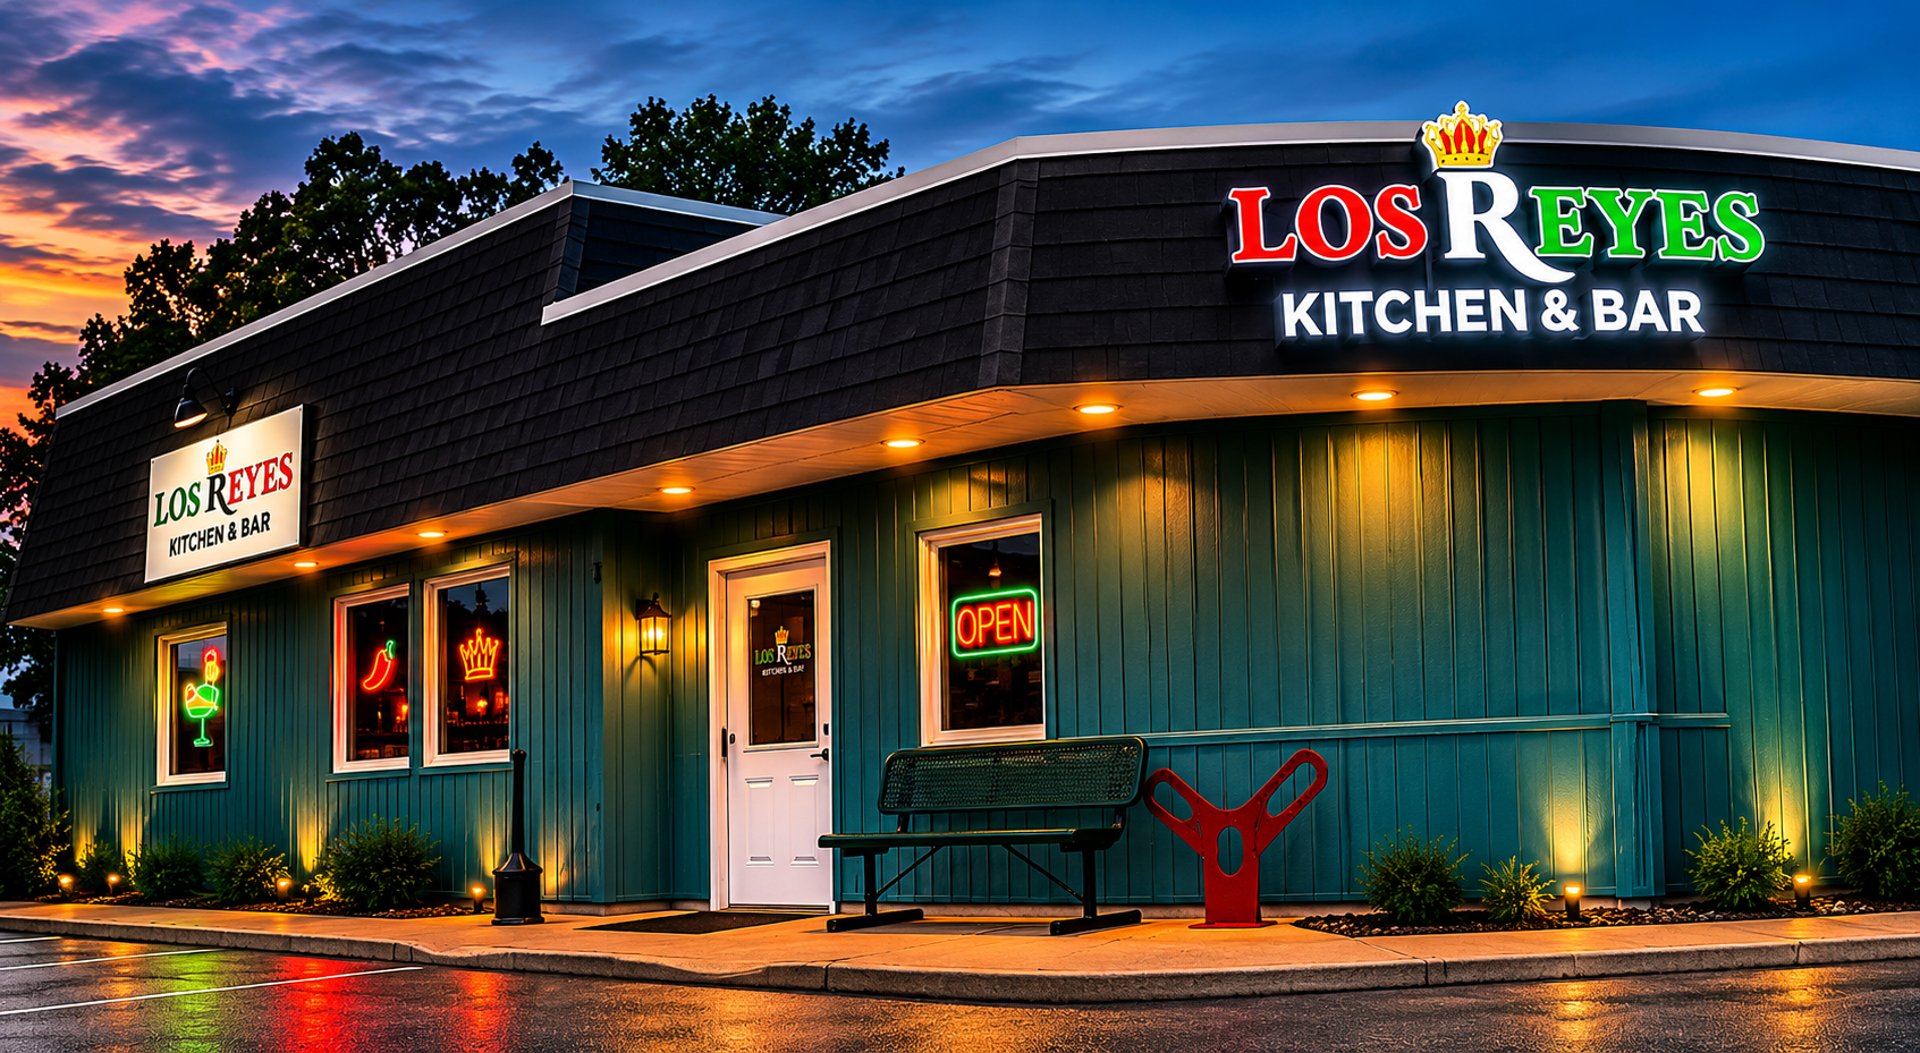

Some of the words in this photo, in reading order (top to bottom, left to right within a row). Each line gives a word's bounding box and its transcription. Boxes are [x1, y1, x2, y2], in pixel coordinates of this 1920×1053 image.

[1229, 185, 1429, 265] LOS
[1436, 171, 1766, 284] REYES
[1282, 289, 1529, 337] KITCHEN
[1543, 289, 1580, 333] &
[1594, 289, 1705, 334] BAR
[153, 481, 201, 527] LOS
[205, 451, 294, 515] REYES
[169, 525, 224, 557] KITCHEN
[228, 521, 237, 542] &
[241, 511, 271, 538] BAR
[957, 600, 1032, 645] OPEN
[754, 648, 775, 665] LOS
